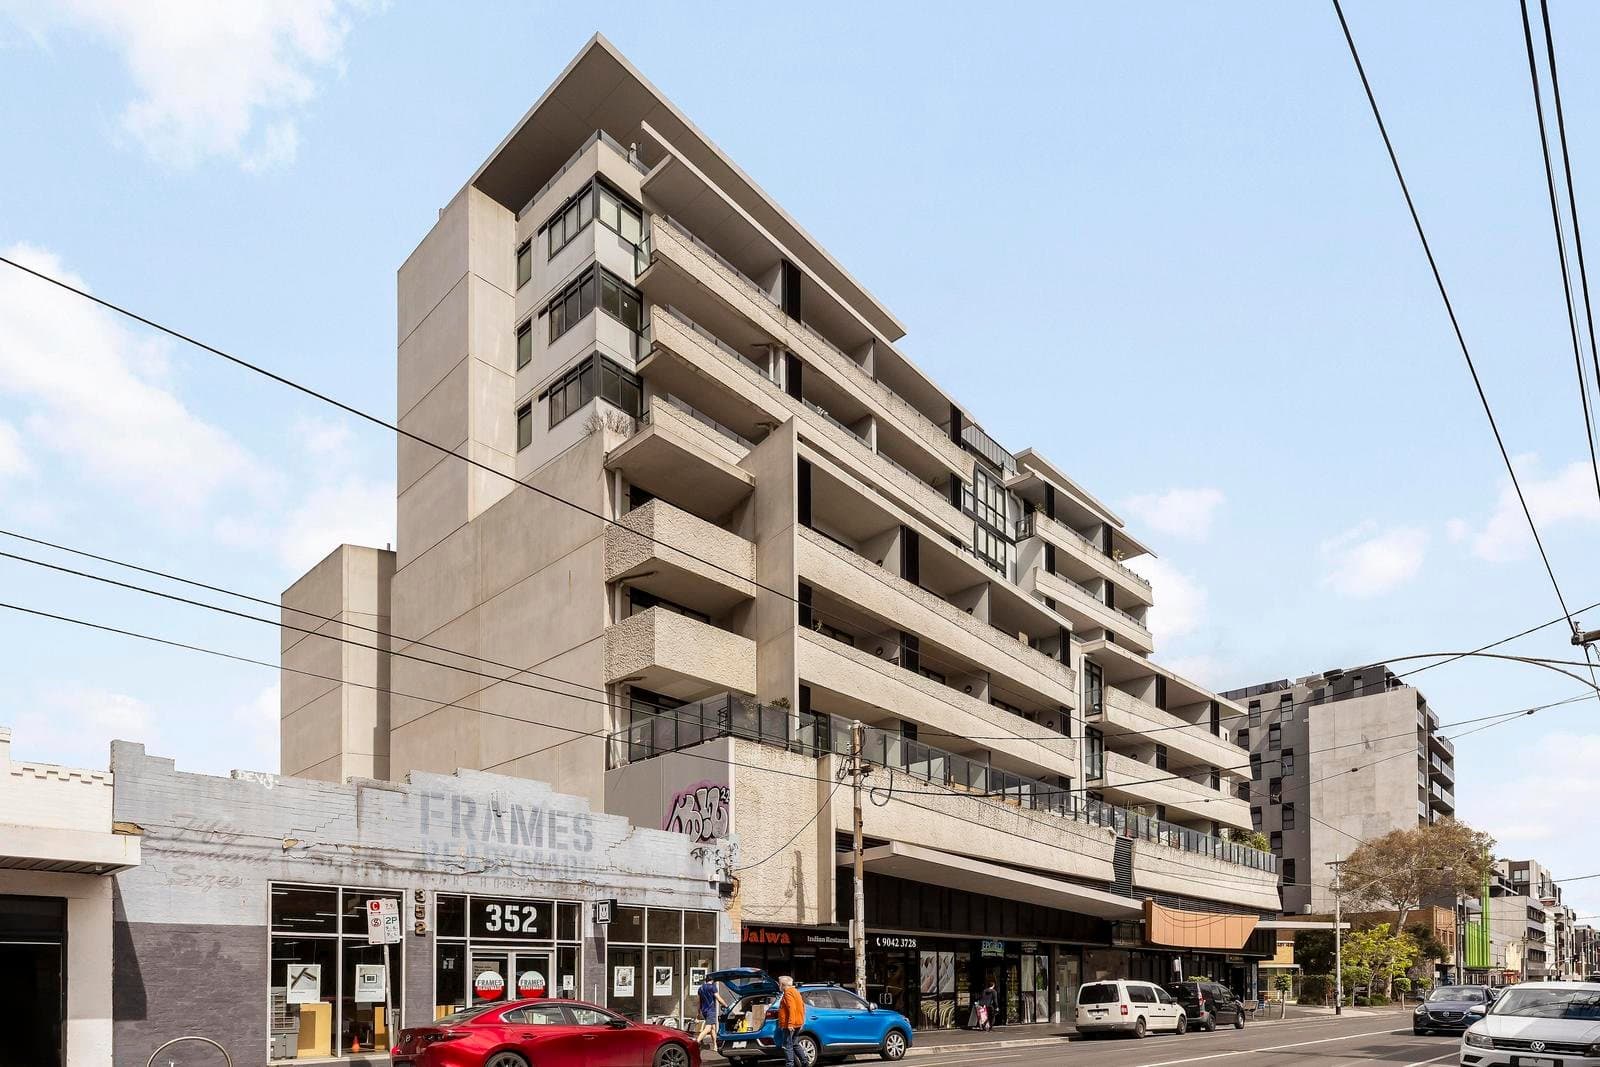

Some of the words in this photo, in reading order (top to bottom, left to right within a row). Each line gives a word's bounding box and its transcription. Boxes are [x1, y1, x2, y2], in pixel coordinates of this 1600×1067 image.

[420, 790, 593, 852] FRAMES
[415, 889, 426, 937] 352
[485, 904, 538, 933] 352
[742, 927, 792, 944] Jalwa
[882, 938, 899, 947] 9042
[900, 939, 917, 948] 3728
